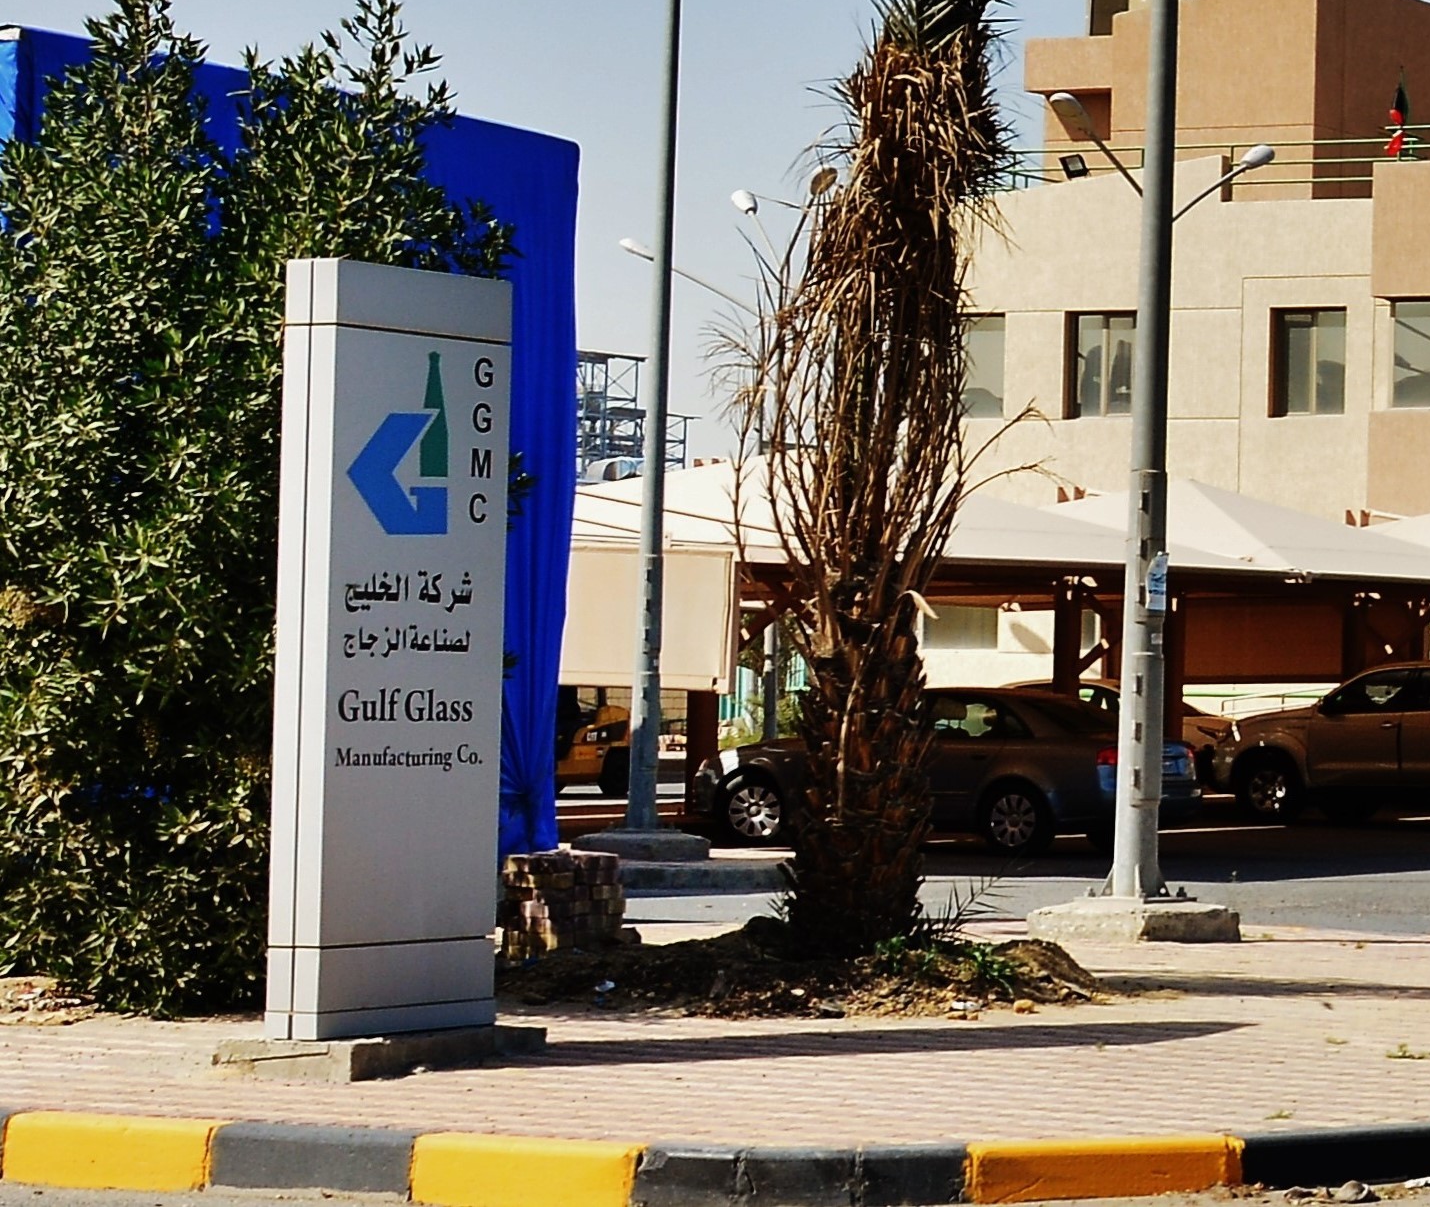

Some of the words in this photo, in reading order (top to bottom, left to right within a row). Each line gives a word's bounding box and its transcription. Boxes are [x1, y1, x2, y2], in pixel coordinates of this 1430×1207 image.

[344, 571, 409, 613] الخليج
[418, 570, 473, 613] شركة
[343, 626, 407, 658] الزجاج
[409, 624, 471, 653] لصناعة
[338, 688, 401, 723] Gulf
[404, 689, 473, 723] Glass
[335, 746, 452, 771] Manufacturing
[457, 744, 483, 765] Co.
